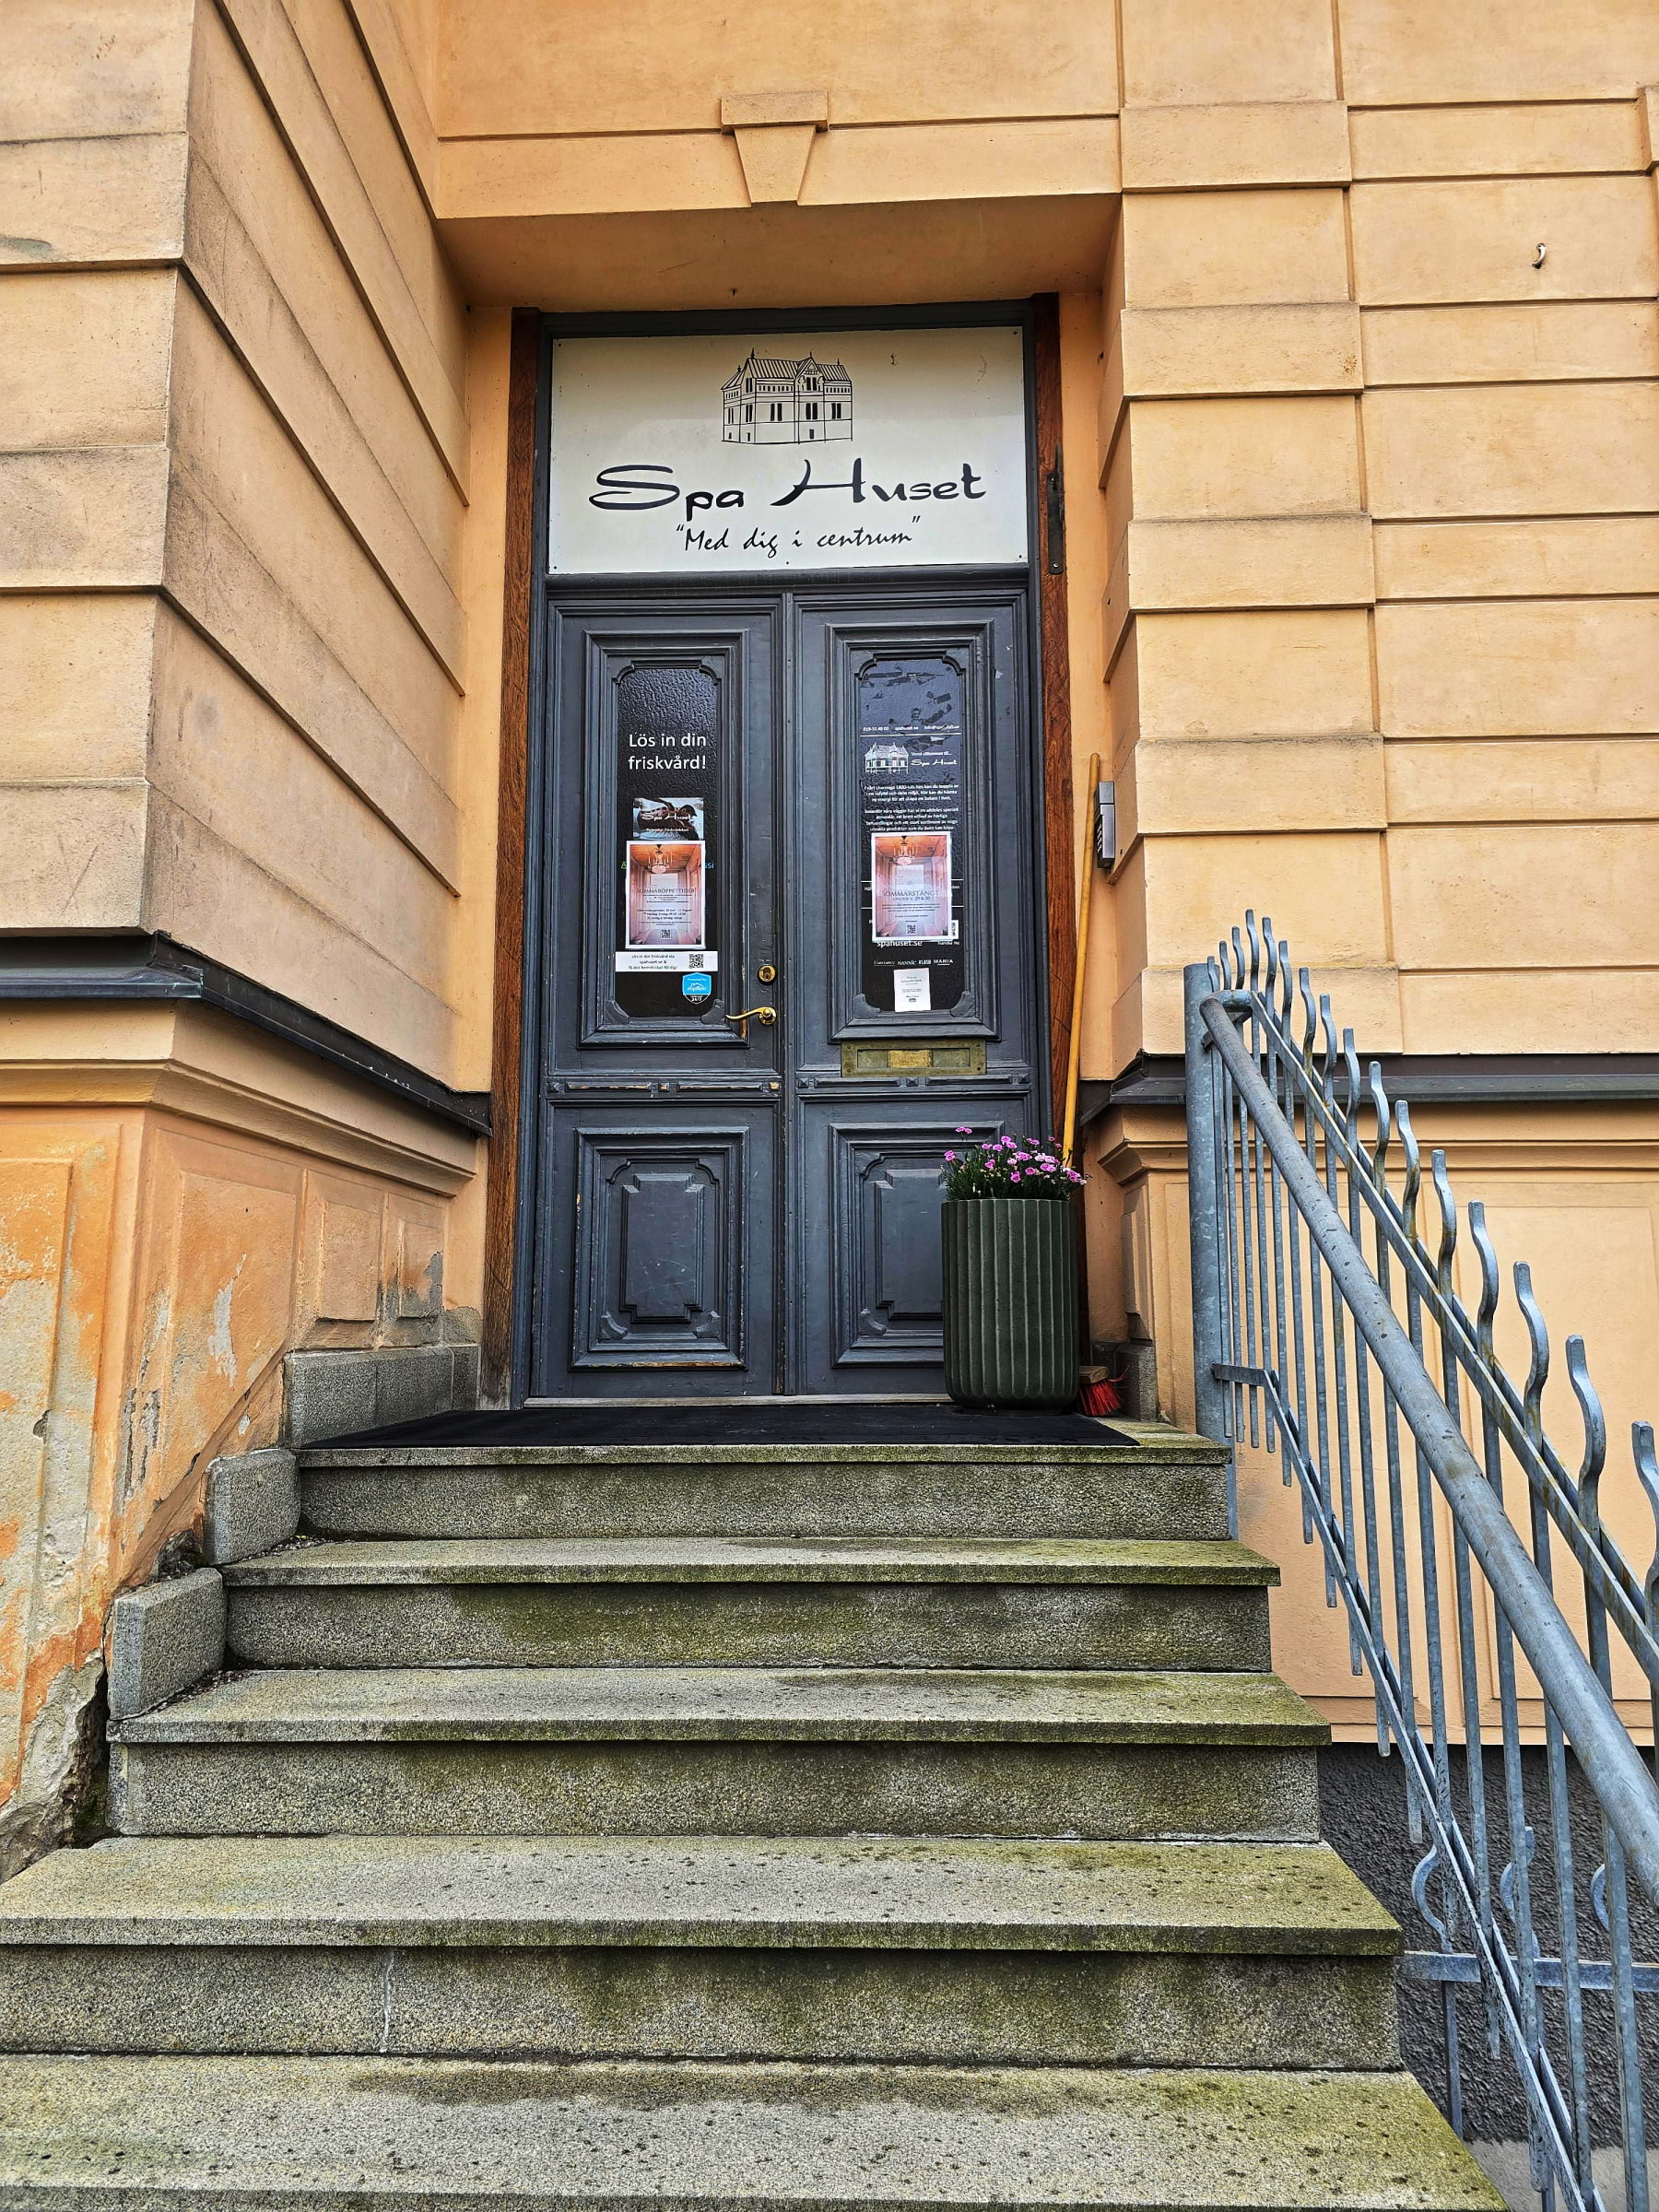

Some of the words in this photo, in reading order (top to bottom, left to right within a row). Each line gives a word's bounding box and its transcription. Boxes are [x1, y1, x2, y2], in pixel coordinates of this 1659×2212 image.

[589, 464, 745, 522] Spa
[771, 457, 987, 507] Huset
[743, 526, 778, 558] dig
[791, 530, 803, 547] i
[629, 734, 655, 747] Lös
[661, 734, 676, 747] in
[680, 733, 707, 747] din
[628, 755, 707, 771] friskvård!
